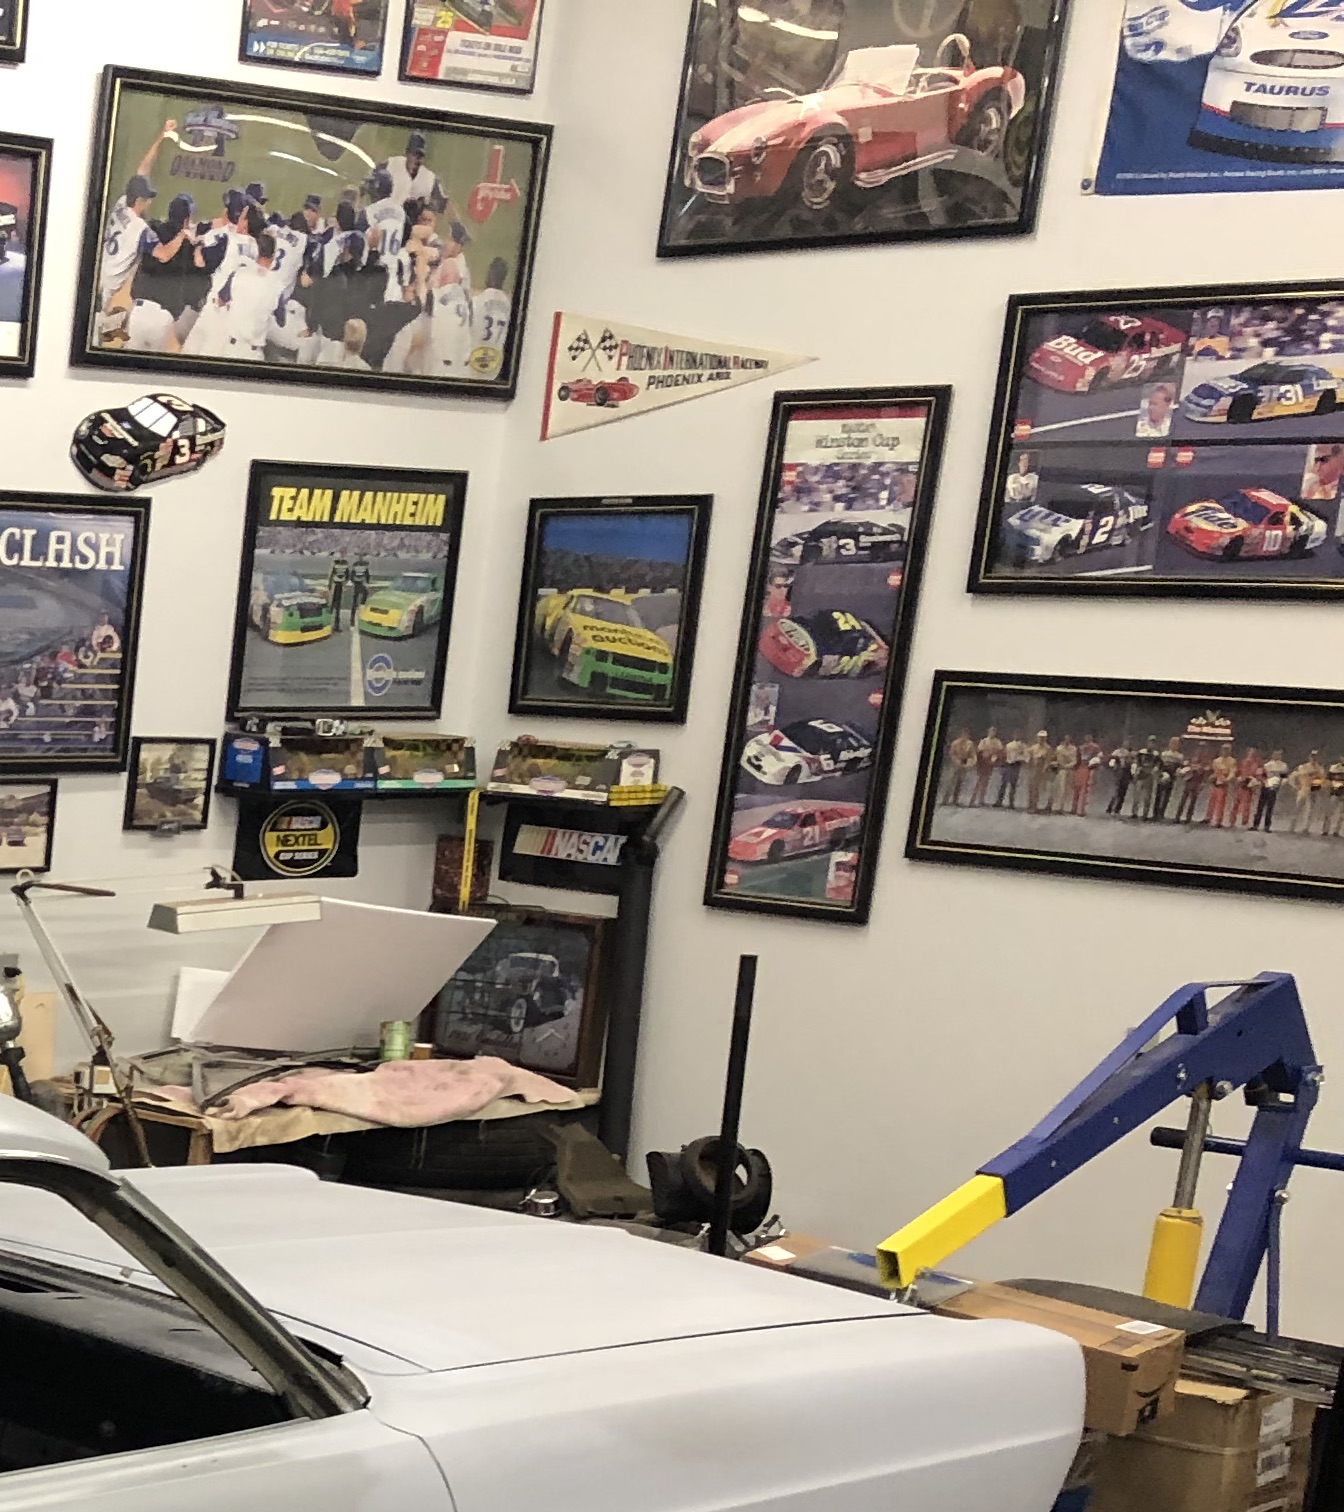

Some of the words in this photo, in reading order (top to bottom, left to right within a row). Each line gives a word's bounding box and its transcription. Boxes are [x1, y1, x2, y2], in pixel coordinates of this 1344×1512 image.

[1243, 80, 1331, 97] TAURUS
[379, 228, 400, 256] 16
[483, 315, 506, 342] 37
[617, 340, 663, 371] PHOENIX
[663, 345, 731, 370] INTERNATIONAL
[732, 355, 770, 370] RACEWAY
[1044, 334, 1105, 364] Bud
[1123, 353, 1150, 378] 25
[646, 372, 704, 391] PHOENIX
[1279, 383, 1305, 406] 31
[175, 438, 191, 465] 3
[815, 433, 869, 449] Winston
[872, 433, 900, 452] Cup
[269, 486, 333, 522] TEAM
[334, 489, 446, 527] MANHEIM
[1184, 506, 1238, 530] Tide
[1092, 515, 1114, 544] 2
[1263, 530, 1283, 551] 10
[838, 538, 856, 556] 3
[831, 611, 862, 631] 24
[820, 753, 834, 771] 6
[275, 832, 323, 848] NEXTEL
[554, 828, 628, 866] NASCA
[802, 826, 820, 846] 21
